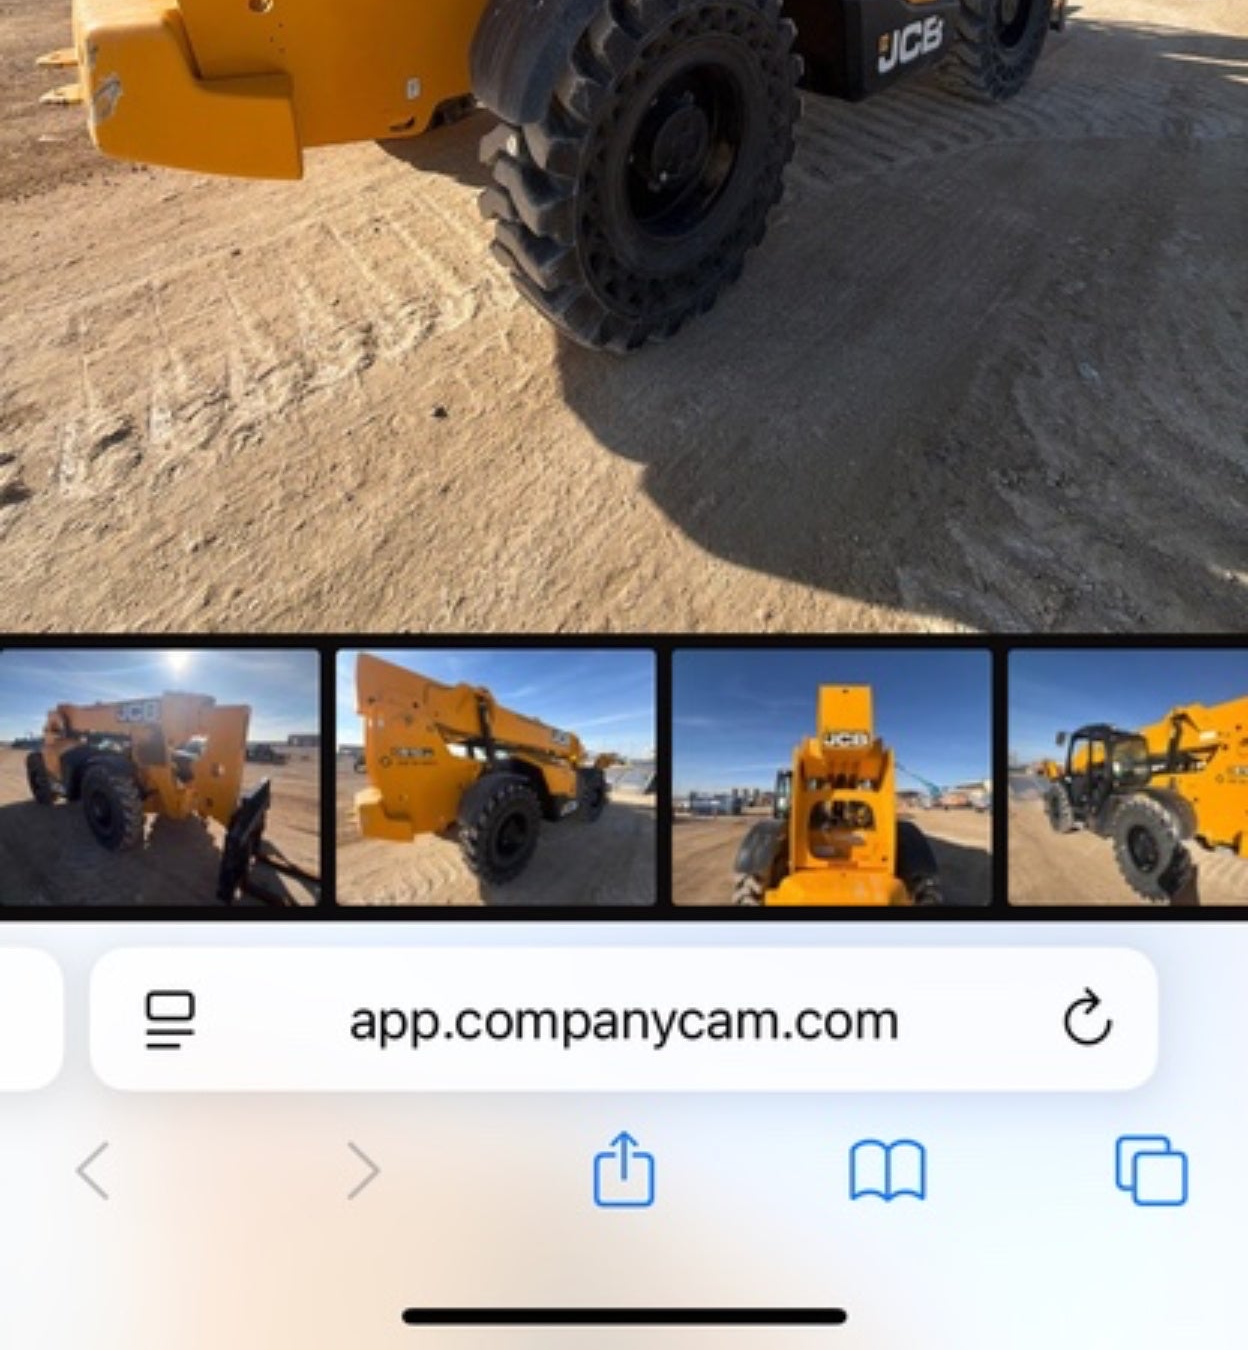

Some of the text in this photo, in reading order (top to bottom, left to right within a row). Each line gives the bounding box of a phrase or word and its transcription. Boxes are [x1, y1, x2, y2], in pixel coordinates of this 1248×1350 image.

[877, 14, 945, 75] JCB
[823, 731, 869, 748] JCB
[349, 1000, 900, 1052] app.companycam.com
